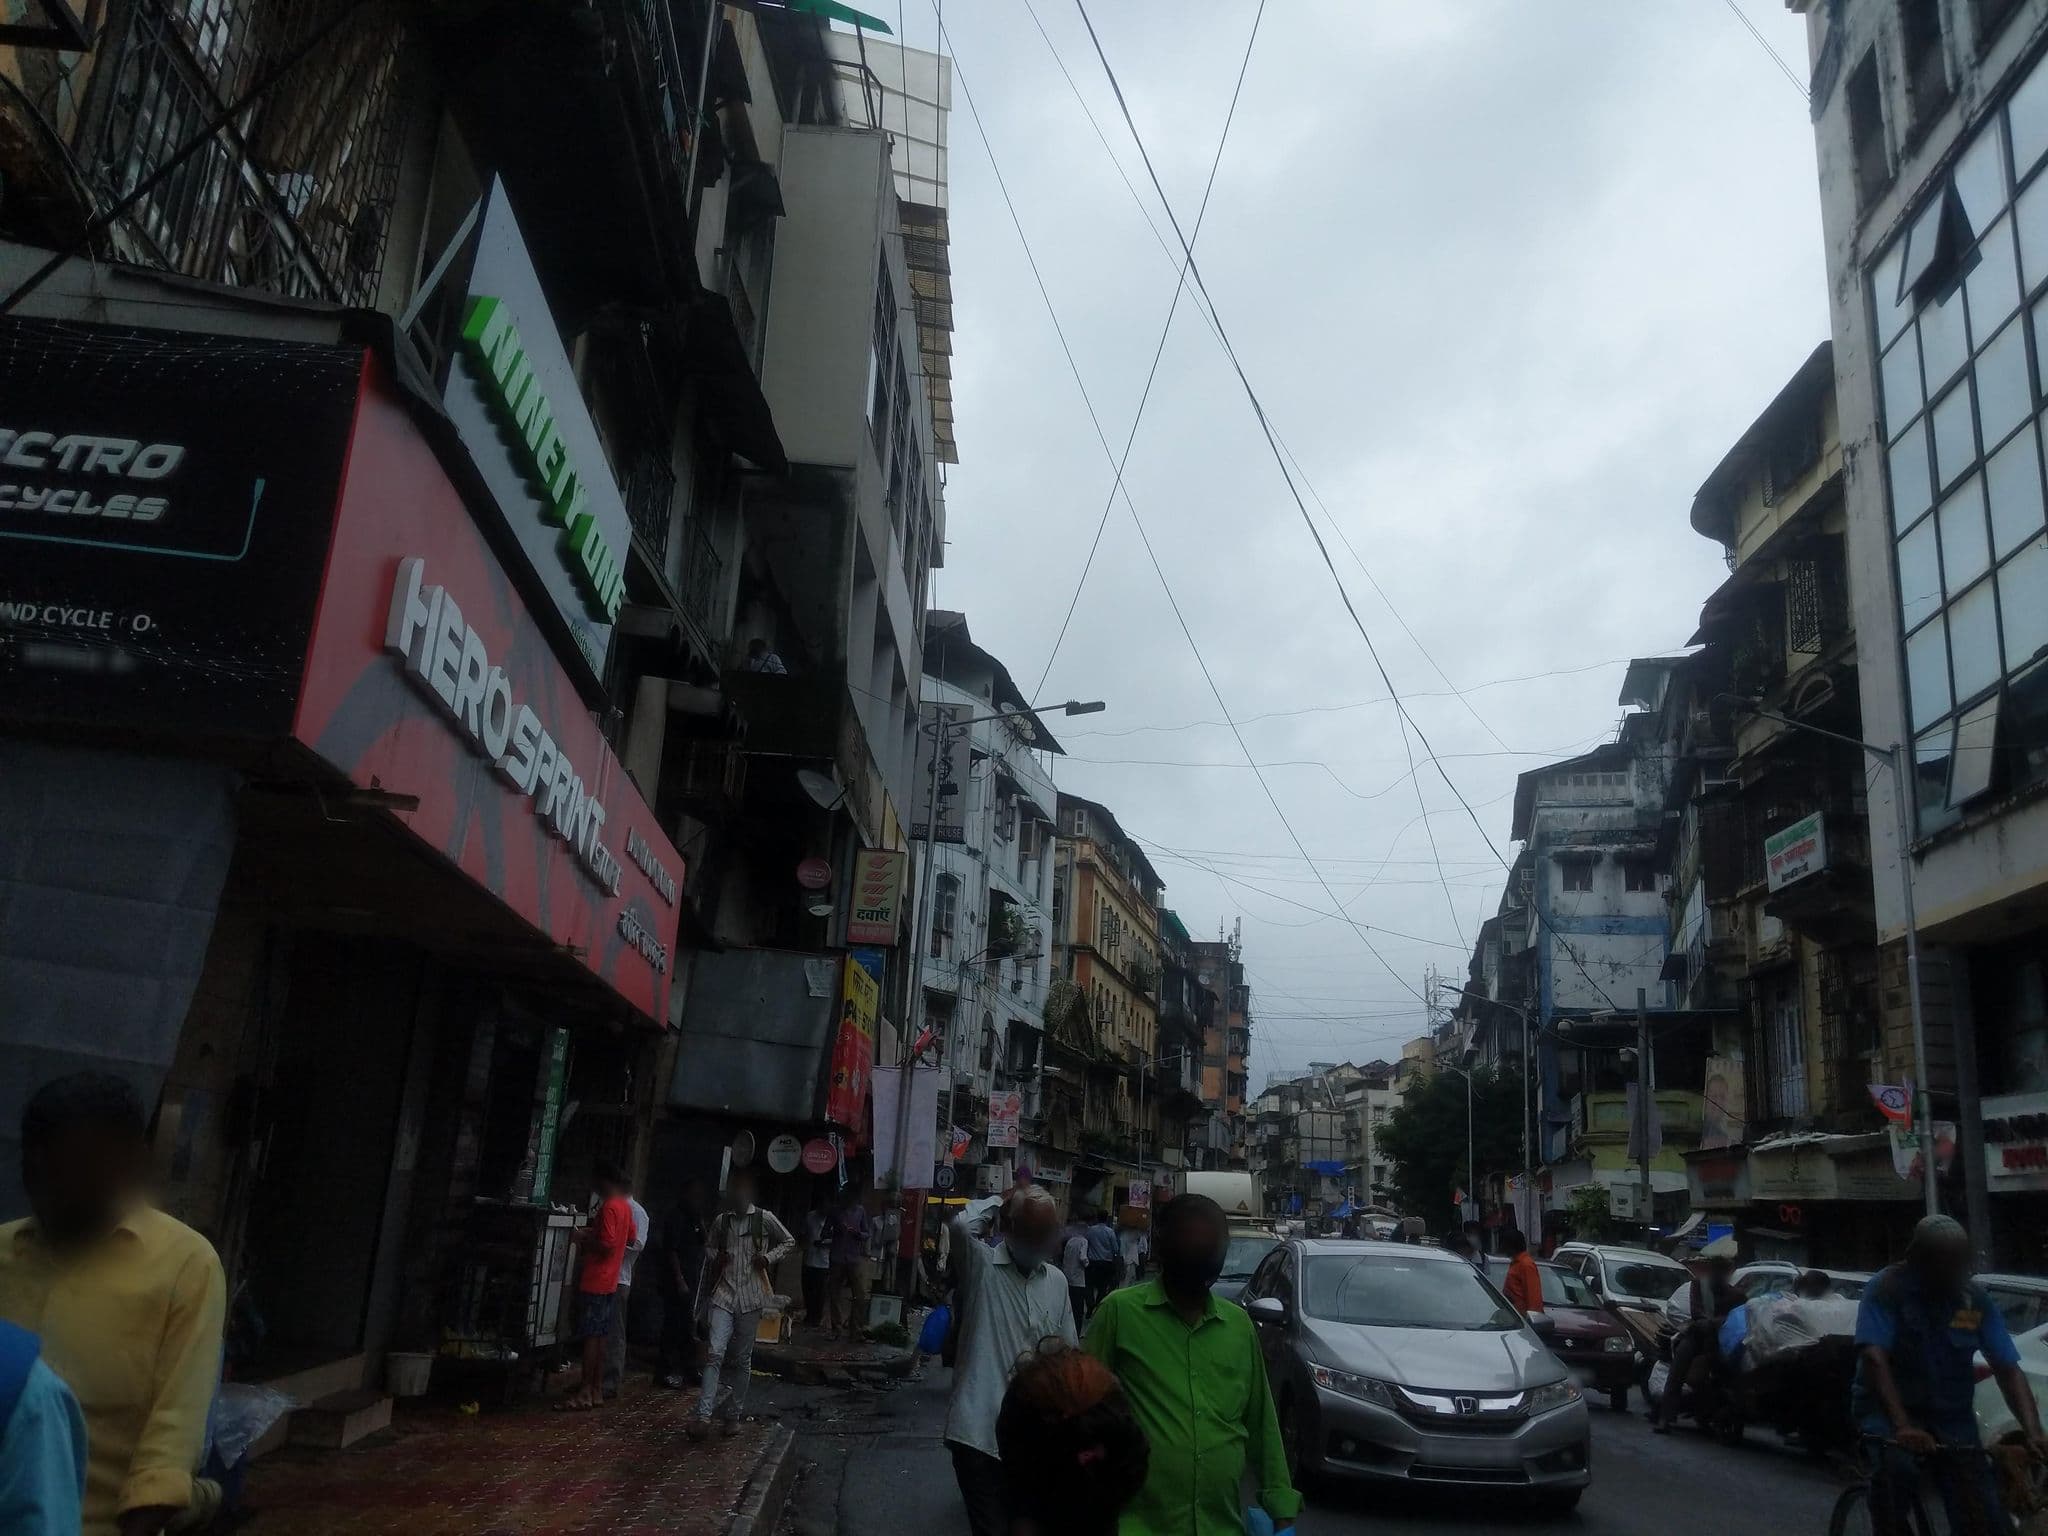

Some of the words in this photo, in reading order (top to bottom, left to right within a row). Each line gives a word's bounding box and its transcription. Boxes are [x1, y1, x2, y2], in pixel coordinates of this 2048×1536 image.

[463, 295, 587, 531] NINETY
[43, 606, 113, 628] CYCLE
[384, 557, 512, 764] HERO
[500, 703, 607, 862] SPRINT
